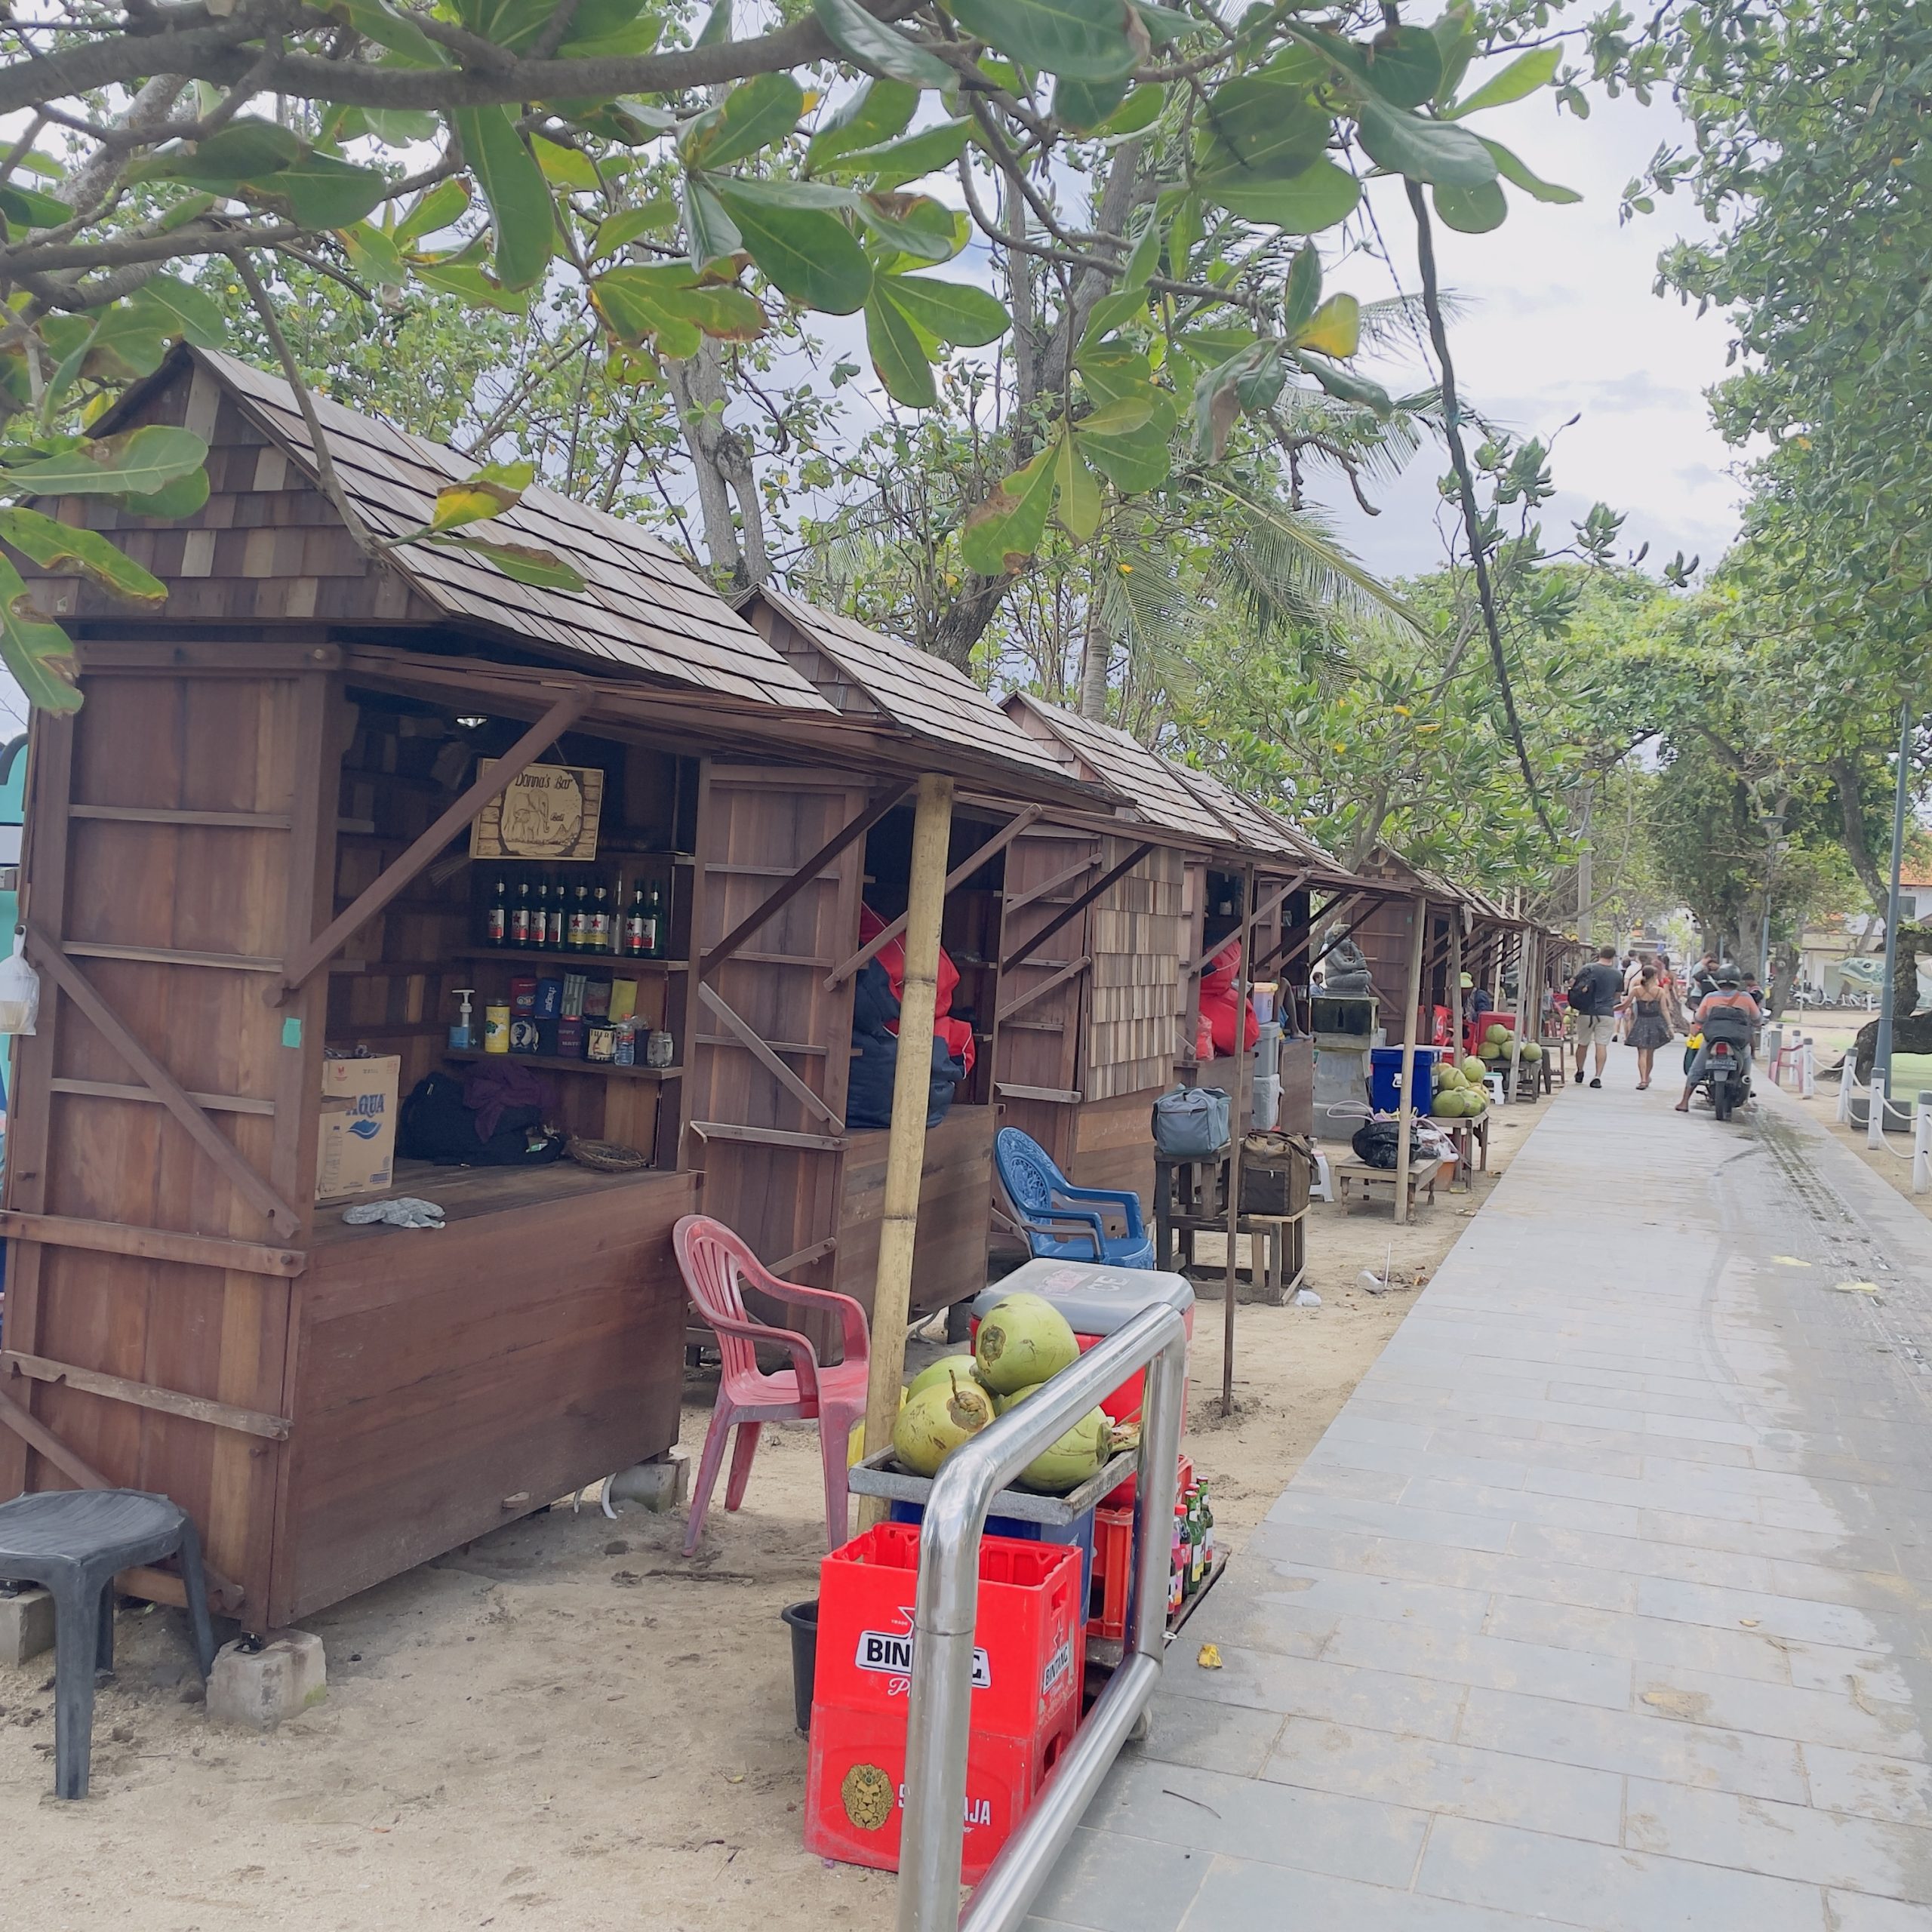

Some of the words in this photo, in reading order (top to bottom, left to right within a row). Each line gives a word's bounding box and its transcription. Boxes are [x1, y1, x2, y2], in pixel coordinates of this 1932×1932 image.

[515, 773, 551, 788] Donna's
[554, 775, 573, 790] Bar
[867, 1638, 982, 1679] BING
[1044, 1646, 1069, 1687] BINTANG
